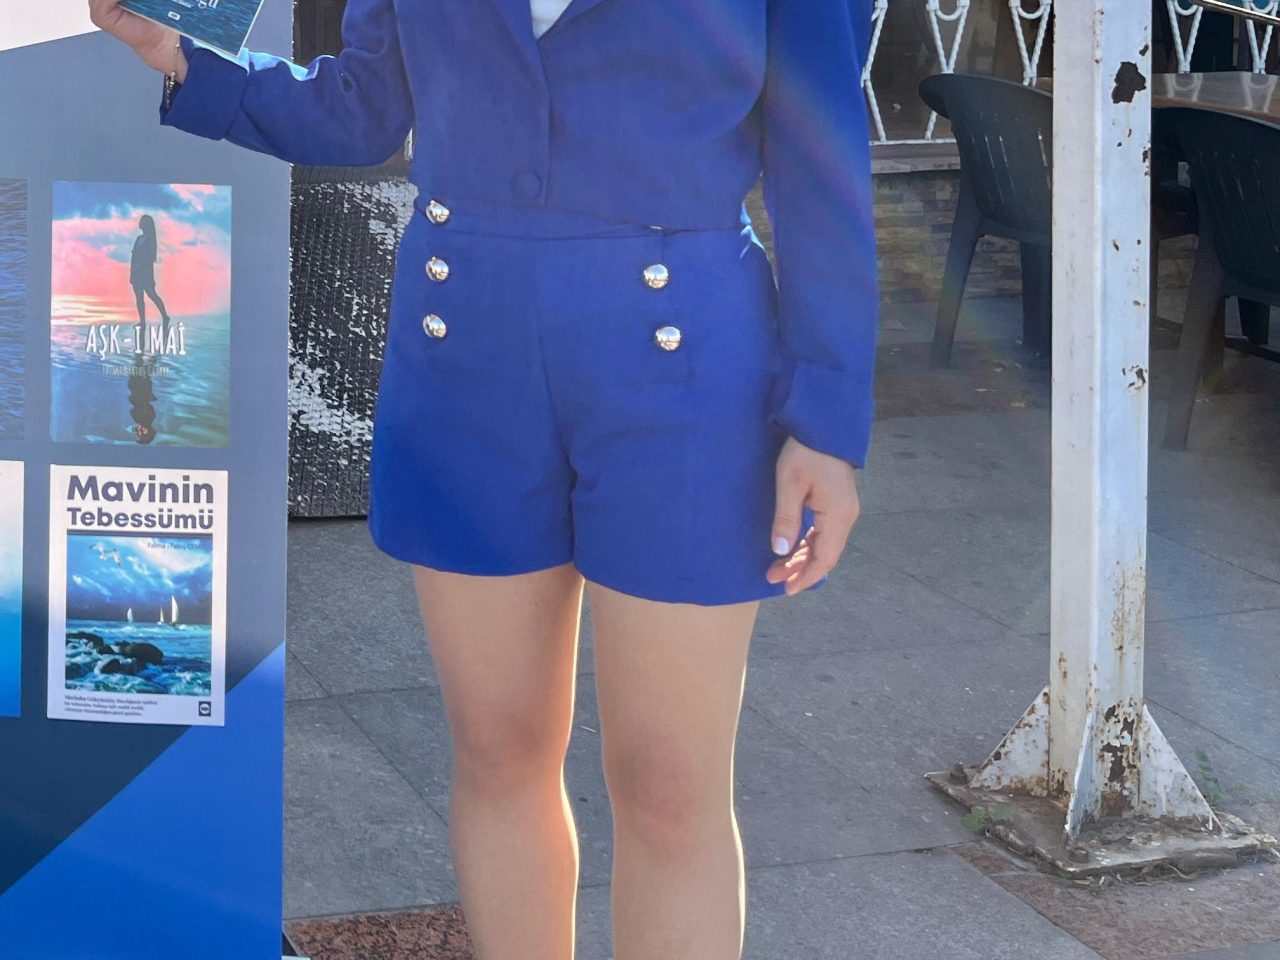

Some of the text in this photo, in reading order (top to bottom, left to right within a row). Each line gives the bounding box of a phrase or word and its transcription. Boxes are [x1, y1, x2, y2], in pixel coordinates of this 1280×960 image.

[150, 322, 187, 355] MAİ
[66, 474, 214, 504] Mavinin
[66, 506, 214, 530] Tebessümü
